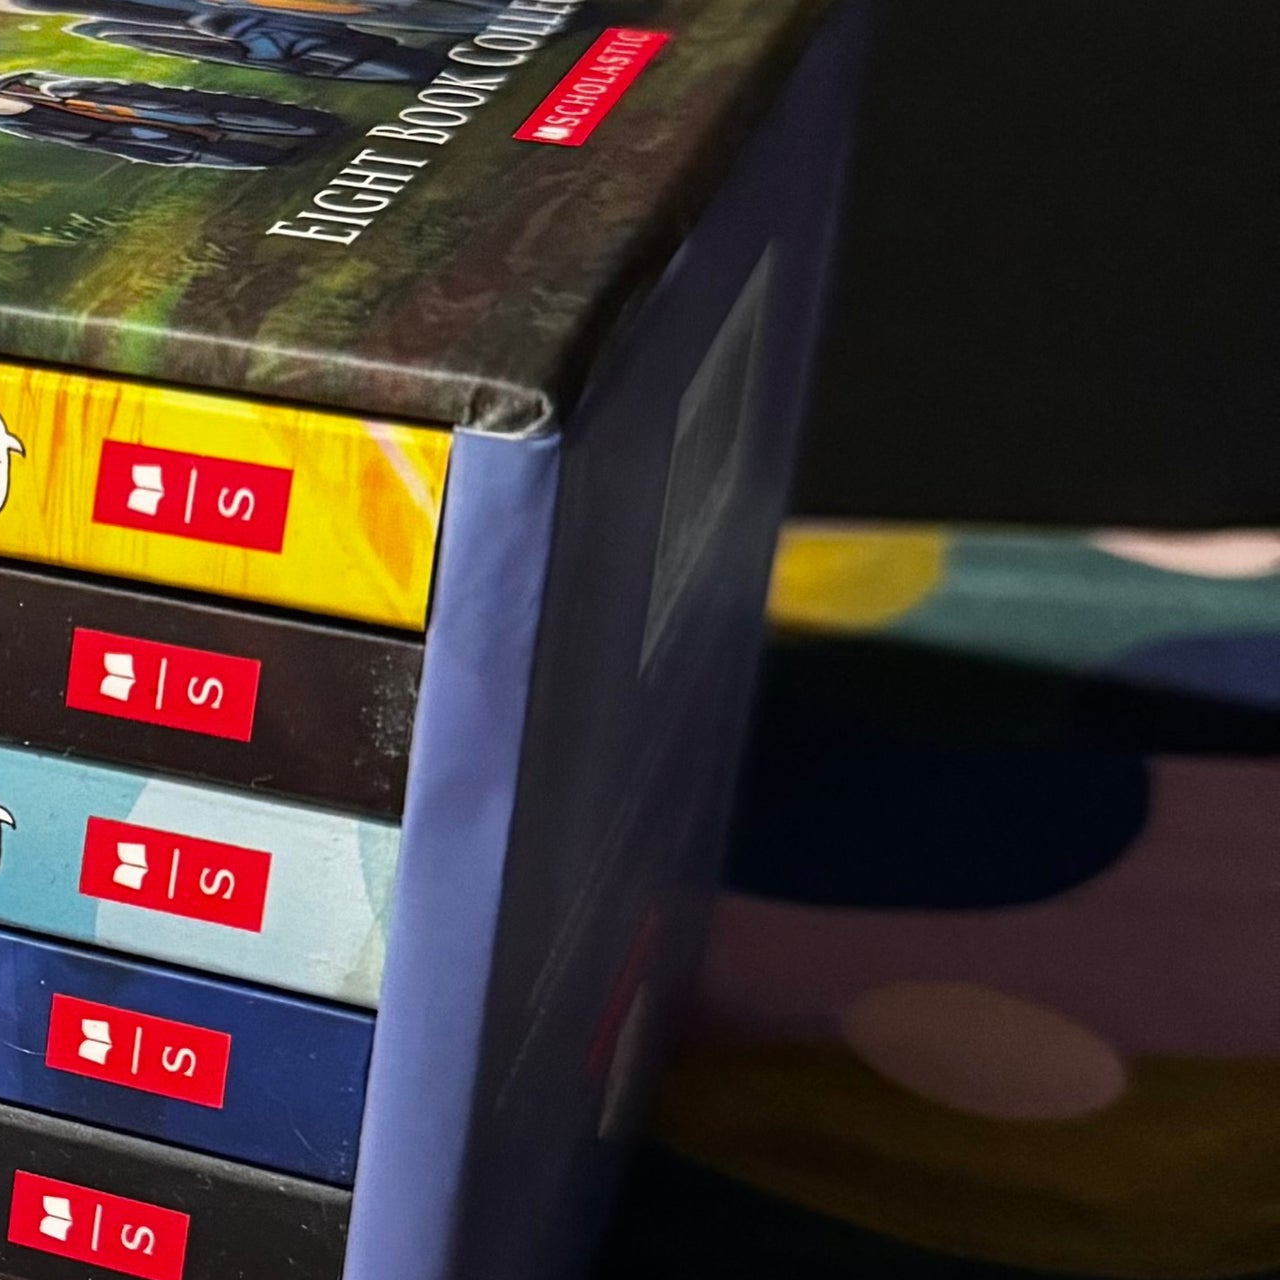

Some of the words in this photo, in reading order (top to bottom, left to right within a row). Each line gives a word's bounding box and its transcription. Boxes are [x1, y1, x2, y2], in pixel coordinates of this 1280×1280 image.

[547, 28, 653, 132] SCHOLASTIC
[265, 149, 430, 246] EIGHT
[366, 72, 510, 146] BOOK
